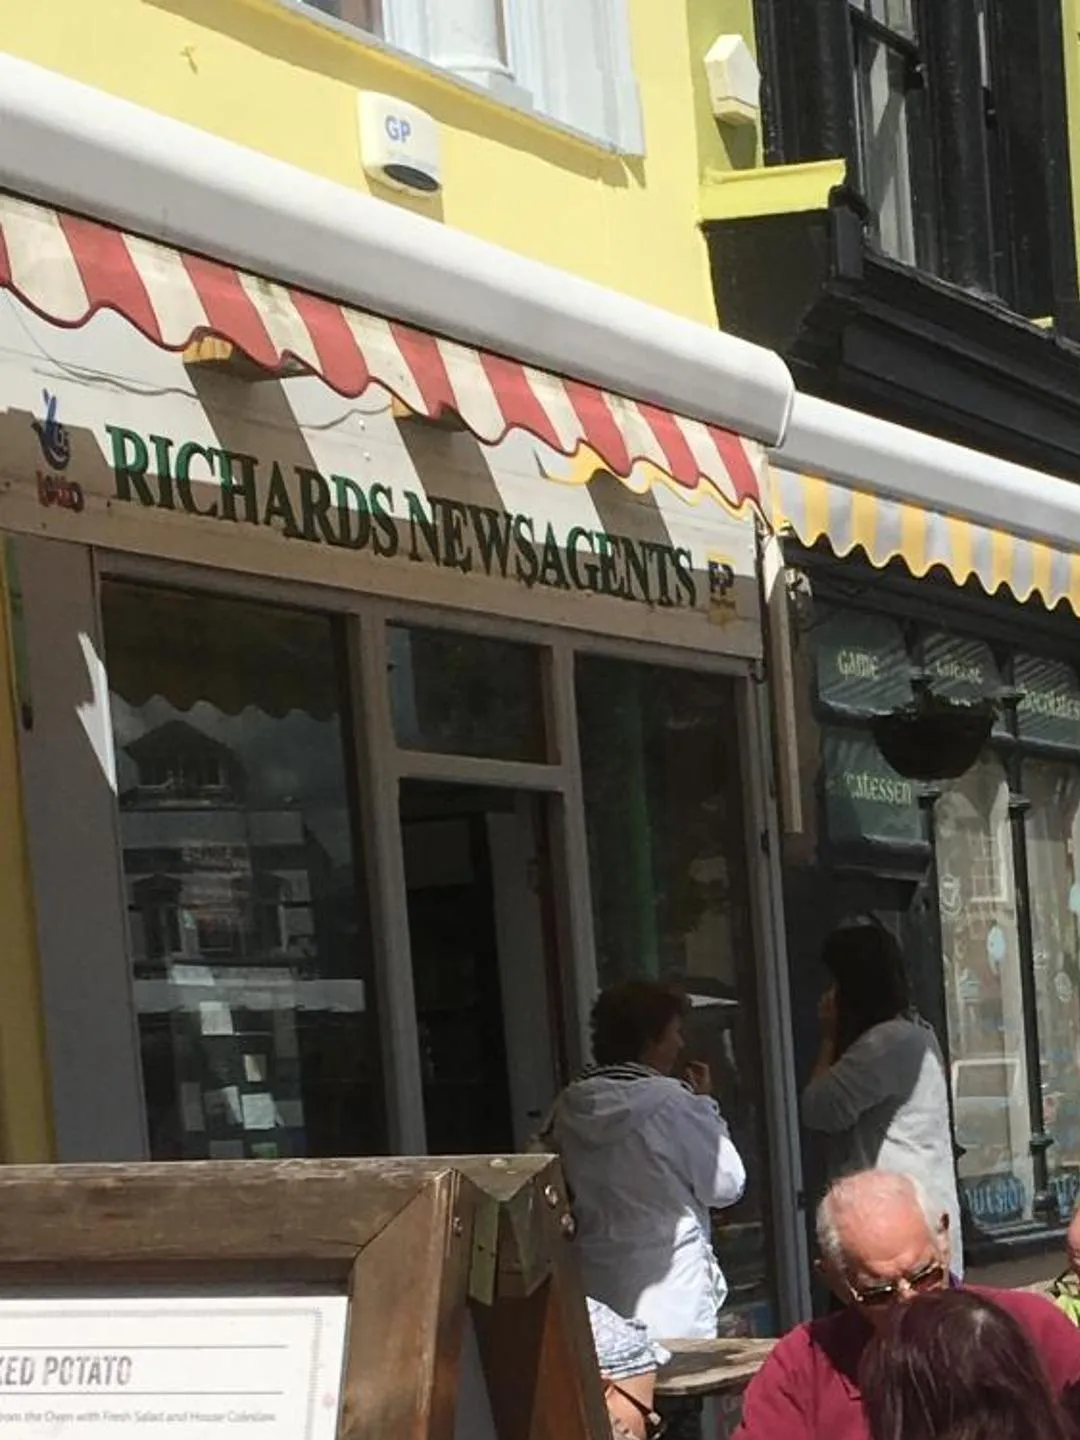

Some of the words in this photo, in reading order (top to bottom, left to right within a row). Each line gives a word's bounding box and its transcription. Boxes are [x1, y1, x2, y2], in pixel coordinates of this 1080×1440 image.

[385, 115, 411, 143] GP
[105, 424, 398, 557] RICHARDS
[404, 490, 697, 607] NEWSAGENTS
[0, 1356, 36, 1386] ED
[43, 1355, 132, 1386] POTATO
